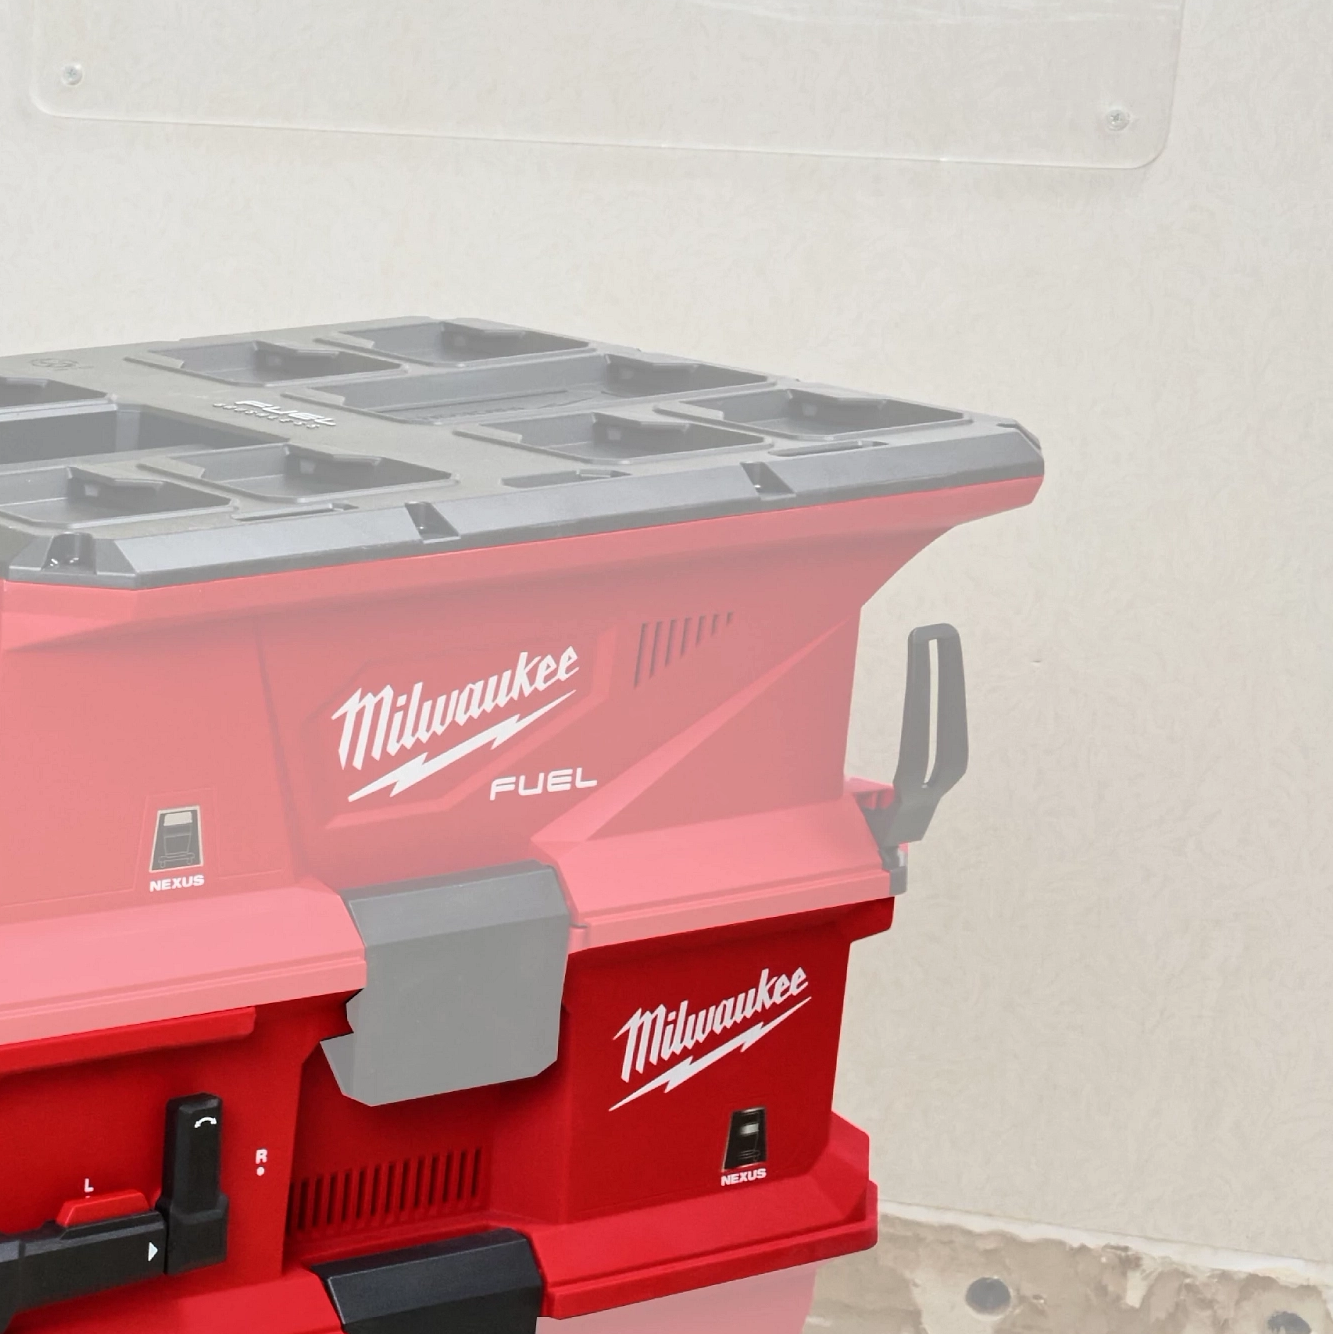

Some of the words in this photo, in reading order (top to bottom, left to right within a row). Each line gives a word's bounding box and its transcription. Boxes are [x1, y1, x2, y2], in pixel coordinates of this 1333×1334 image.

[331, 646, 579, 770] Milwaukee
[490, 767, 597, 801] FUEL
[148, 873, 205, 892] NEXUS
[613, 967, 809, 1083] Milwaukee
[255, 1148, 268, 1165] R
[84, 1178, 94, 1193] L
[721, 1168, 767, 1187] NEXUS
